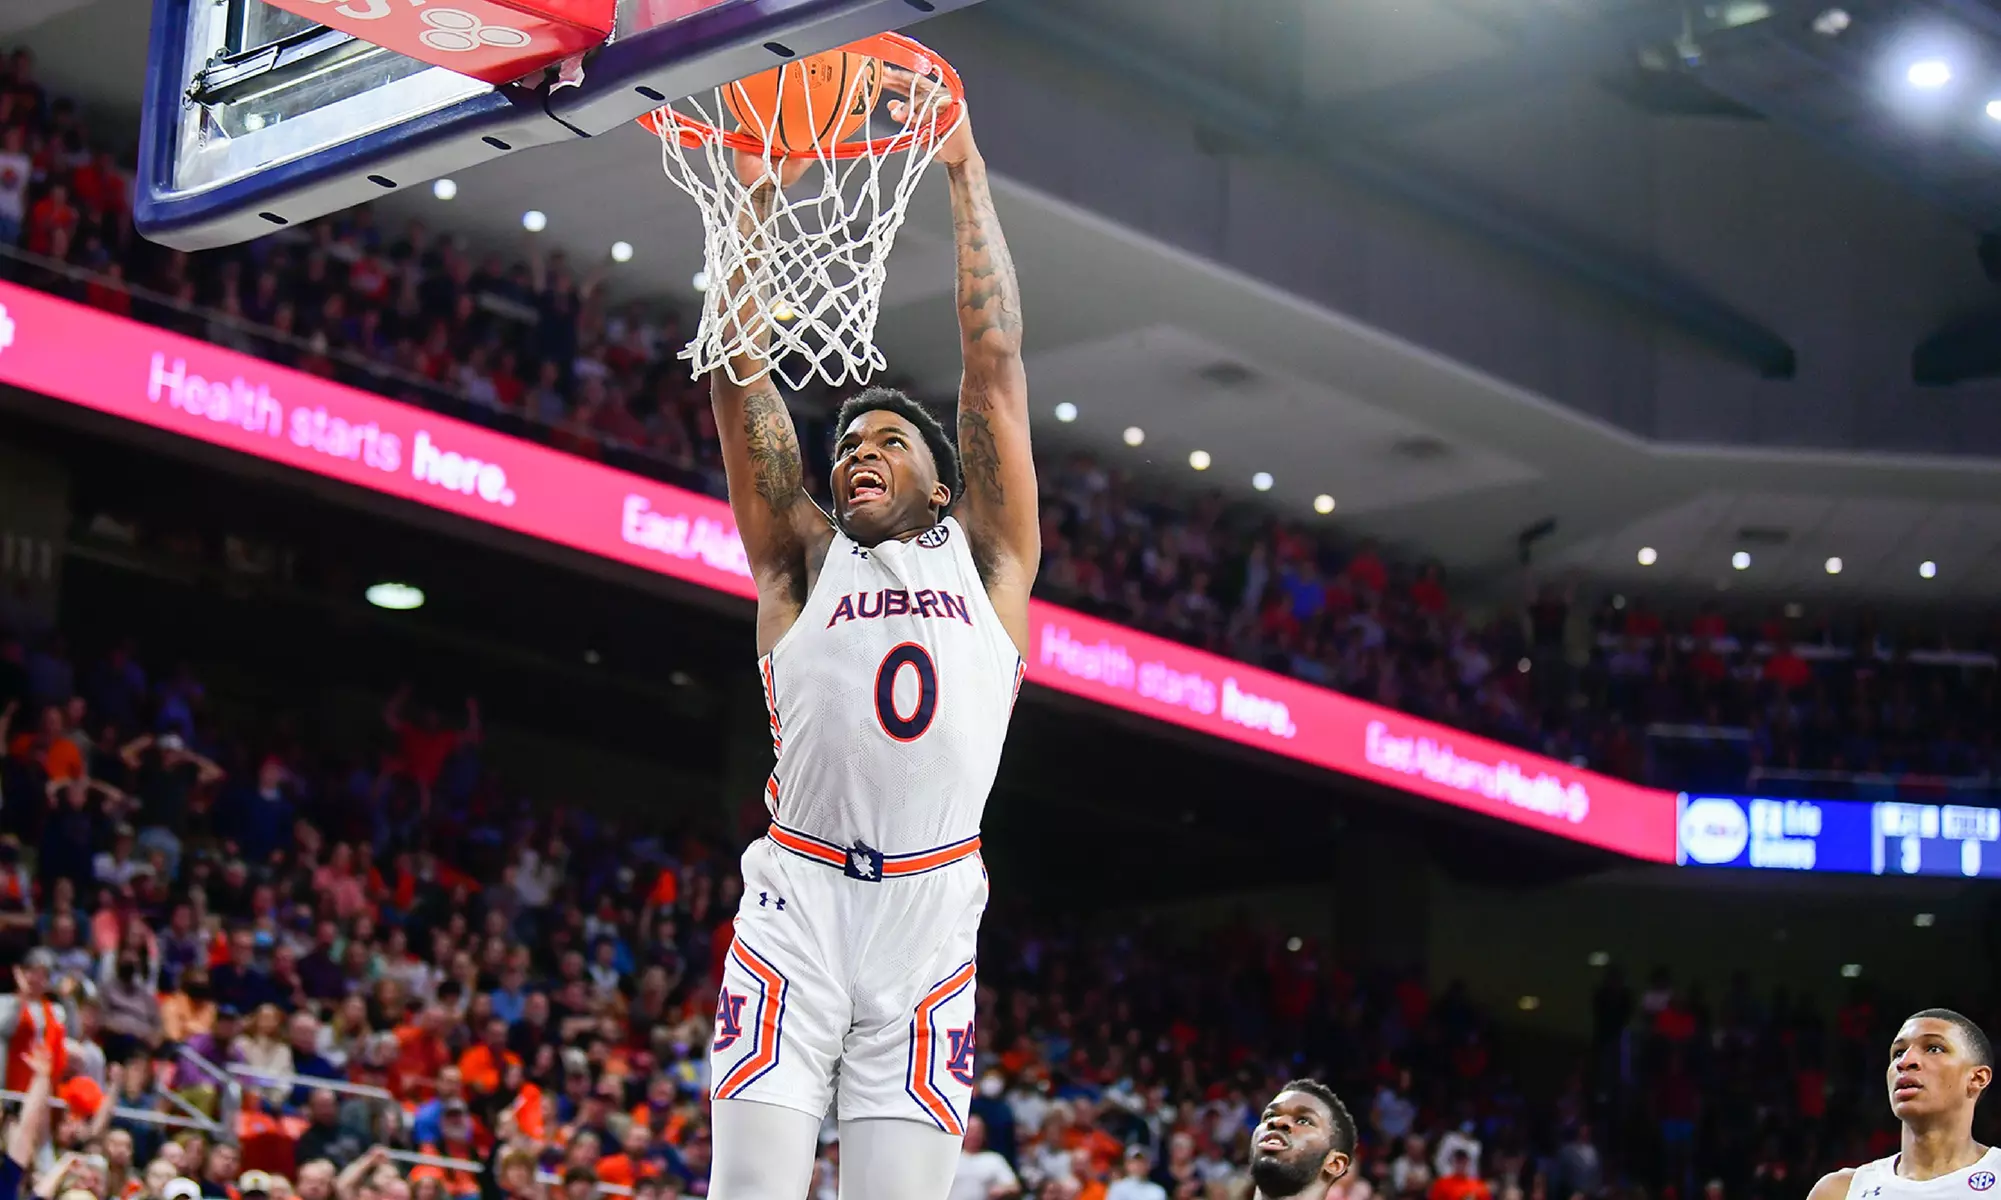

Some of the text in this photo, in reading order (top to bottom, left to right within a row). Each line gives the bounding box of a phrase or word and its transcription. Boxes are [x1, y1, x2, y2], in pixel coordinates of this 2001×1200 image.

[148, 351, 516, 507] Health starts here.
[917, 525, 949, 548] SEC
[826, 587, 974, 630] AUBRN
[873, 641, 939, 743] 0
[1040, 623, 1297, 739] Health starts here.
[1968, 1171, 1996, 1191] SEC
